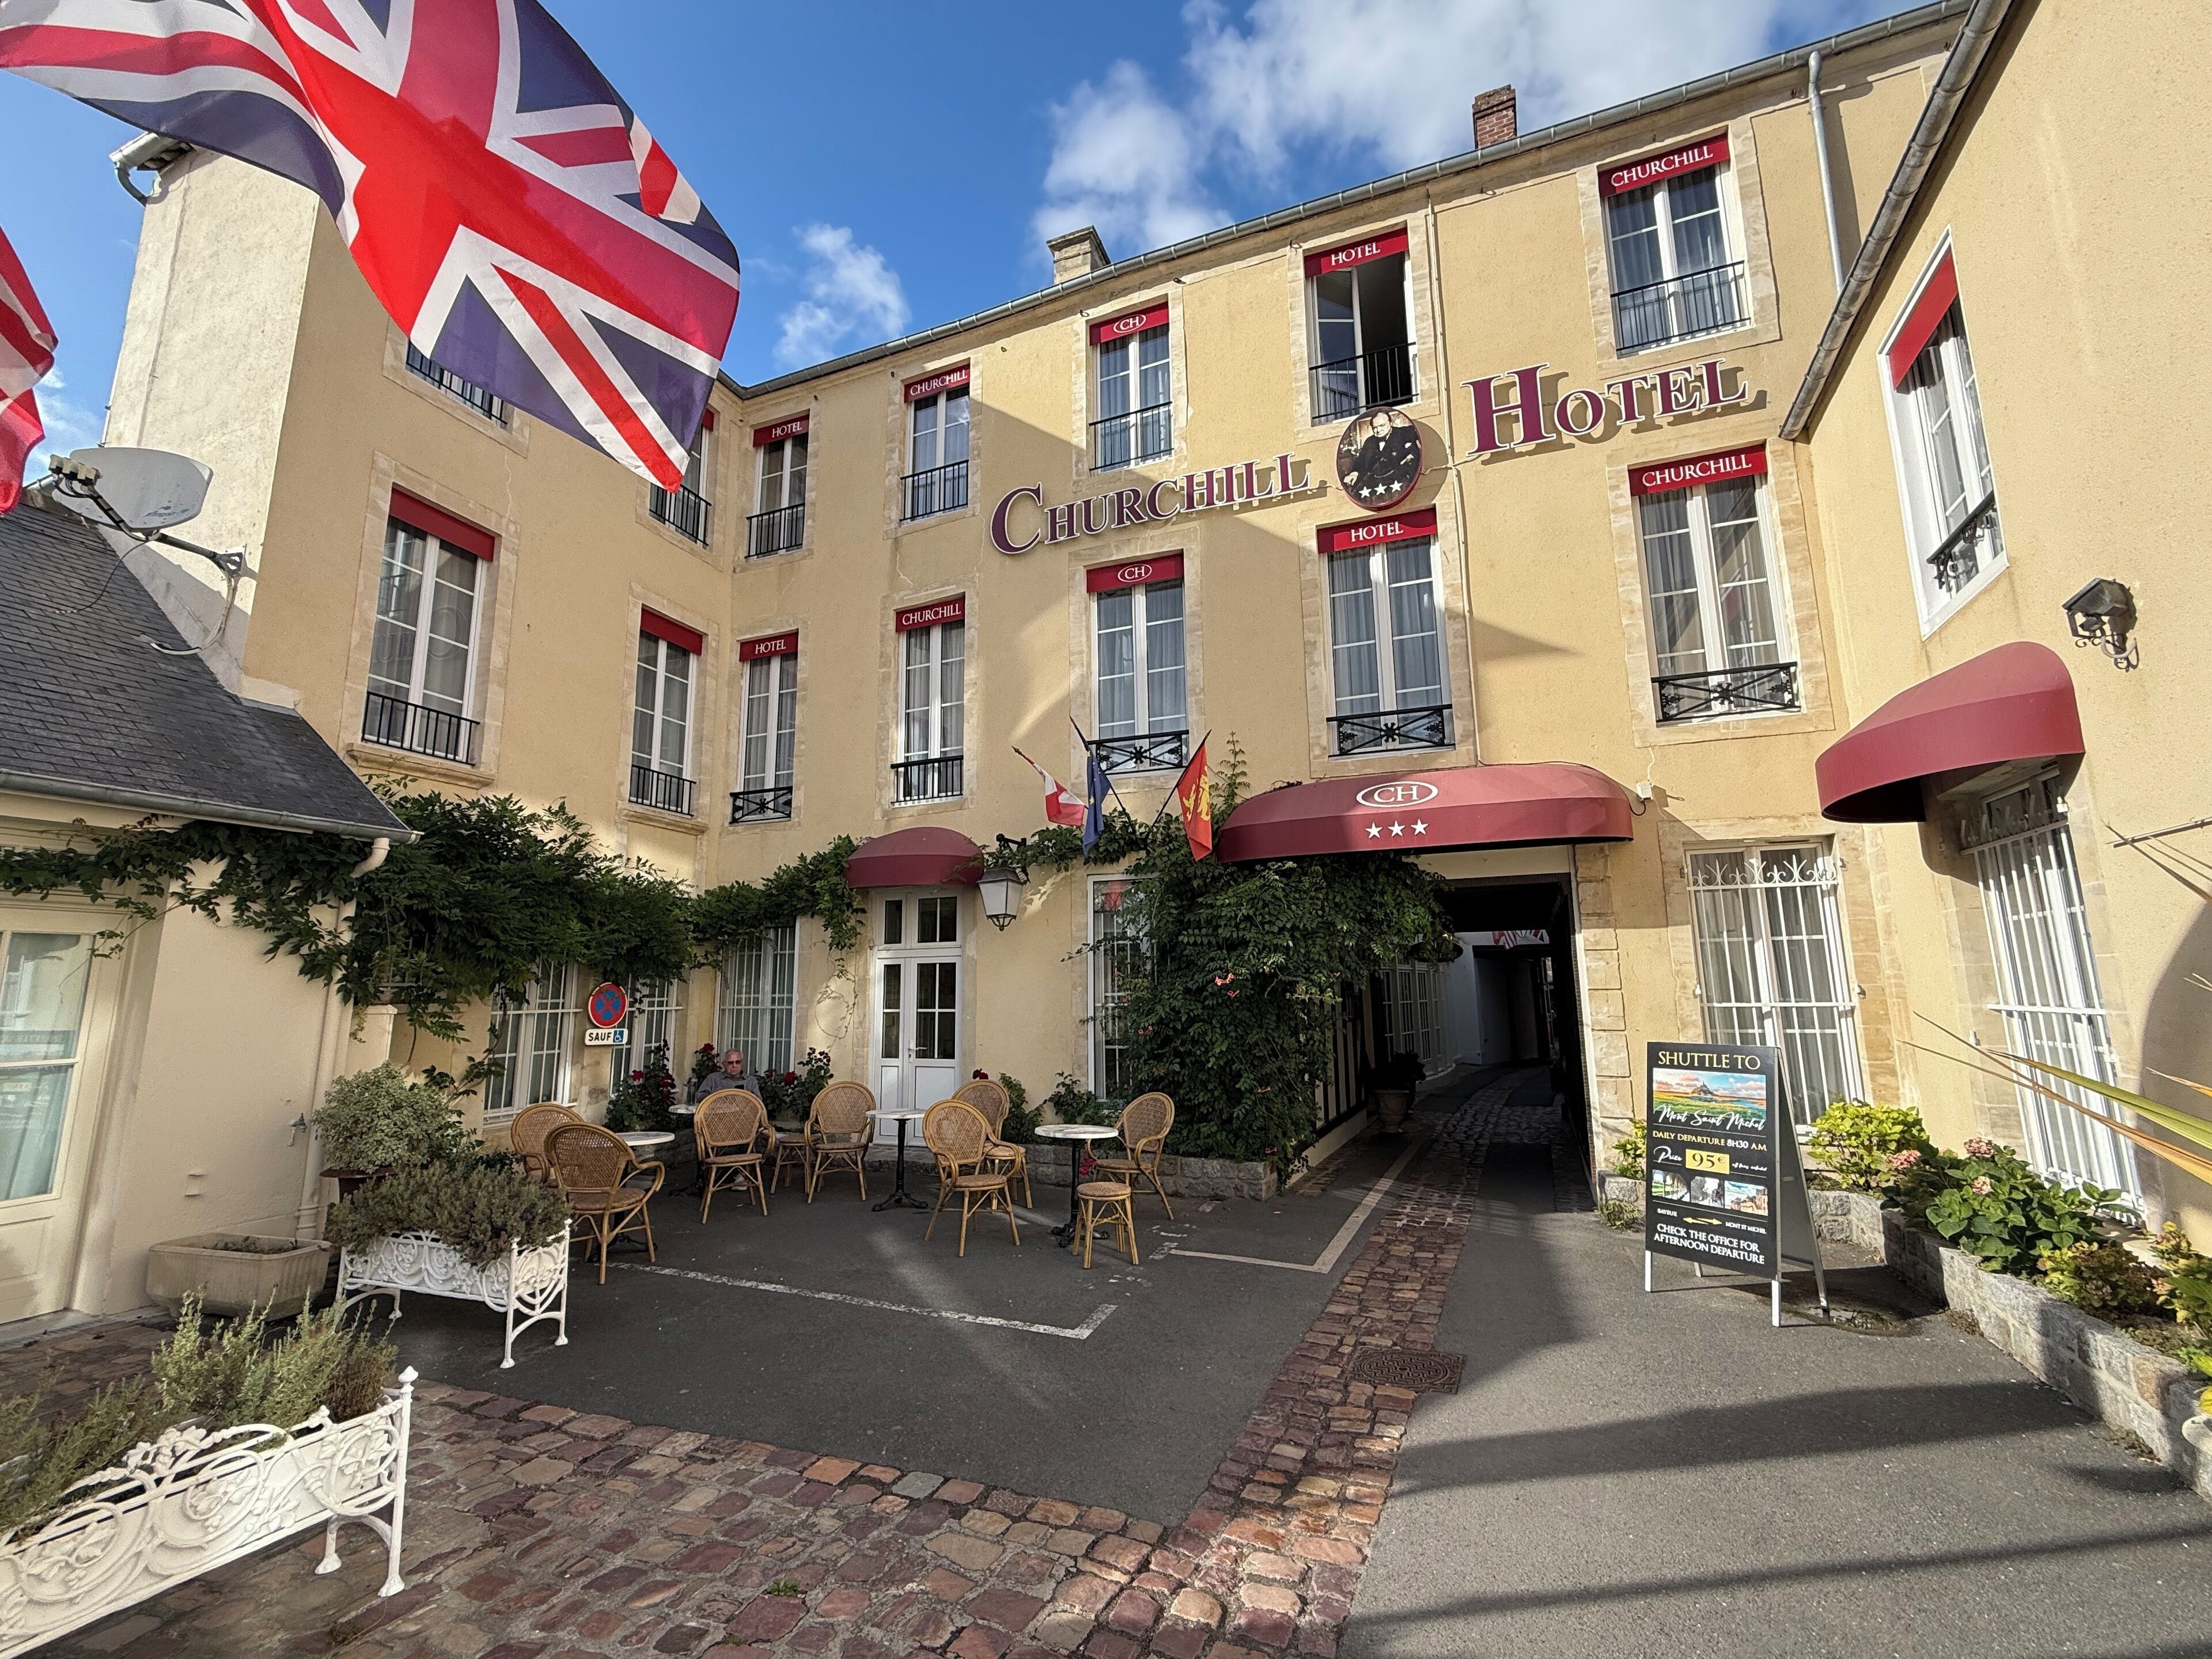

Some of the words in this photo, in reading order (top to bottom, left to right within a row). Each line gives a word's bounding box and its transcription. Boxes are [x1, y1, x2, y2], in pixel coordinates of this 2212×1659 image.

[1611, 146, 1713, 187] CHURCHILL
[1331, 242, 1381, 266] HOTEL
[1120, 316, 1139, 330] CH
[910, 369, 968, 396] CHURCHILL
[1460, 358, 1749, 457] HOTEL
[772, 421, 802, 438] HOTEL
[1642, 454, 1752, 487] CHURCHILL
[990, 451, 1312, 555] CHURCHILL
[1350, 521, 1404, 543] HOTEL
[1124, 566, 1146, 579] CH
[902, 602, 961, 626] CHURCHILL
[755, 639, 787, 654] HOTEL
[1373, 785, 1419, 802] CH
[588, 1032, 612, 1041] SAUF
[1658, 1051, 1730, 1069] SHUTTLE
[1733, 1055, 1761, 1070] TO
[1653, 1105, 1690, 1123] Mont
[1690, 1109, 1725, 1126] Saint
[1721, 1112, 1766, 1131] Michel
[1653, 1130, 1676, 1140] DAILY
[1677, 1134, 1725, 1146] DEPARTURE
[1726, 1139, 1749, 1149] 8H30
[1750, 1143, 1767, 1152] AM
[1653, 1146, 1683, 1163] Price
[1657, 1208, 1677, 1217] BAYEUX
[1725, 1221, 1741, 1230] MONT
[1654, 1233, 1709, 1252] AFTERNOON
[1710, 1244, 1766, 1264] DEPARTURE
[1657, 1224, 1688, 1237] CHECK
[1688, 1229, 1707, 1242] THE
[1708, 1234, 1738, 1248] OFFICE
[1740, 1240, 1760, 1253] FOR
